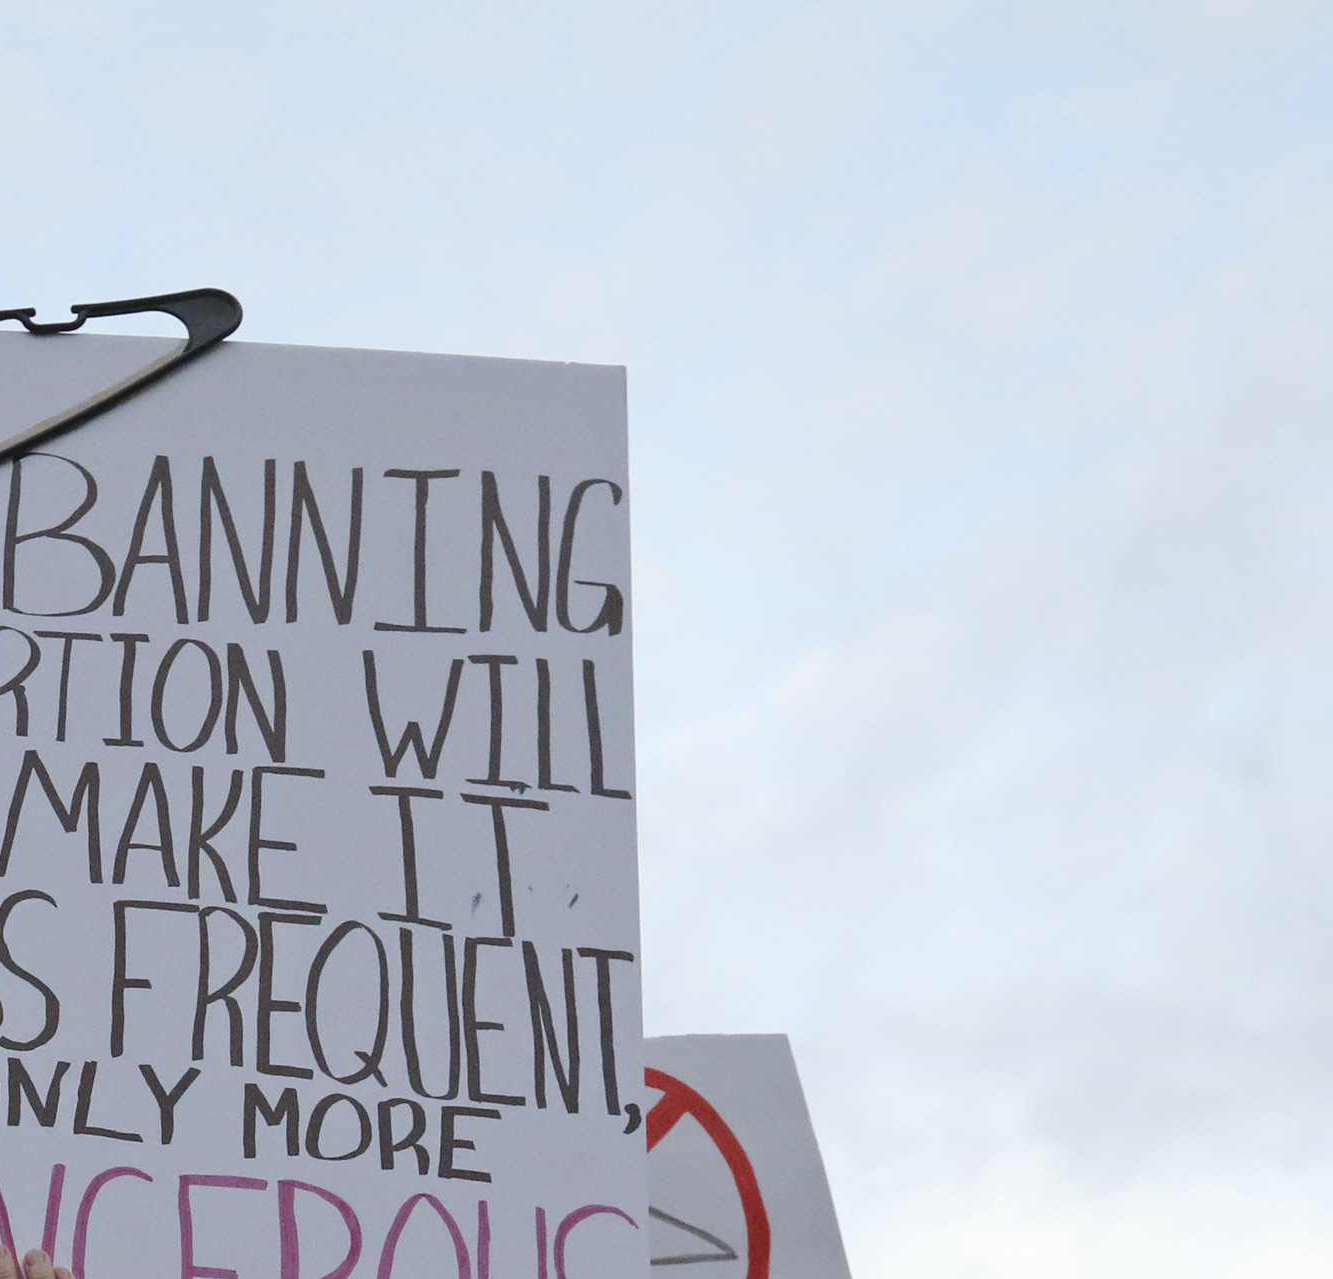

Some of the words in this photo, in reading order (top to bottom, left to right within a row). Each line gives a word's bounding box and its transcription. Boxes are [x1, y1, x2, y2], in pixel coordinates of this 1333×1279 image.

[2, 451, 624, 637] BANNING
[362, 650, 632, 799] WILL
[369, 786, 549, 936] IT
[109, 900, 643, 1135] FREQUENT,
[242, 1082, 501, 1183] MORE
